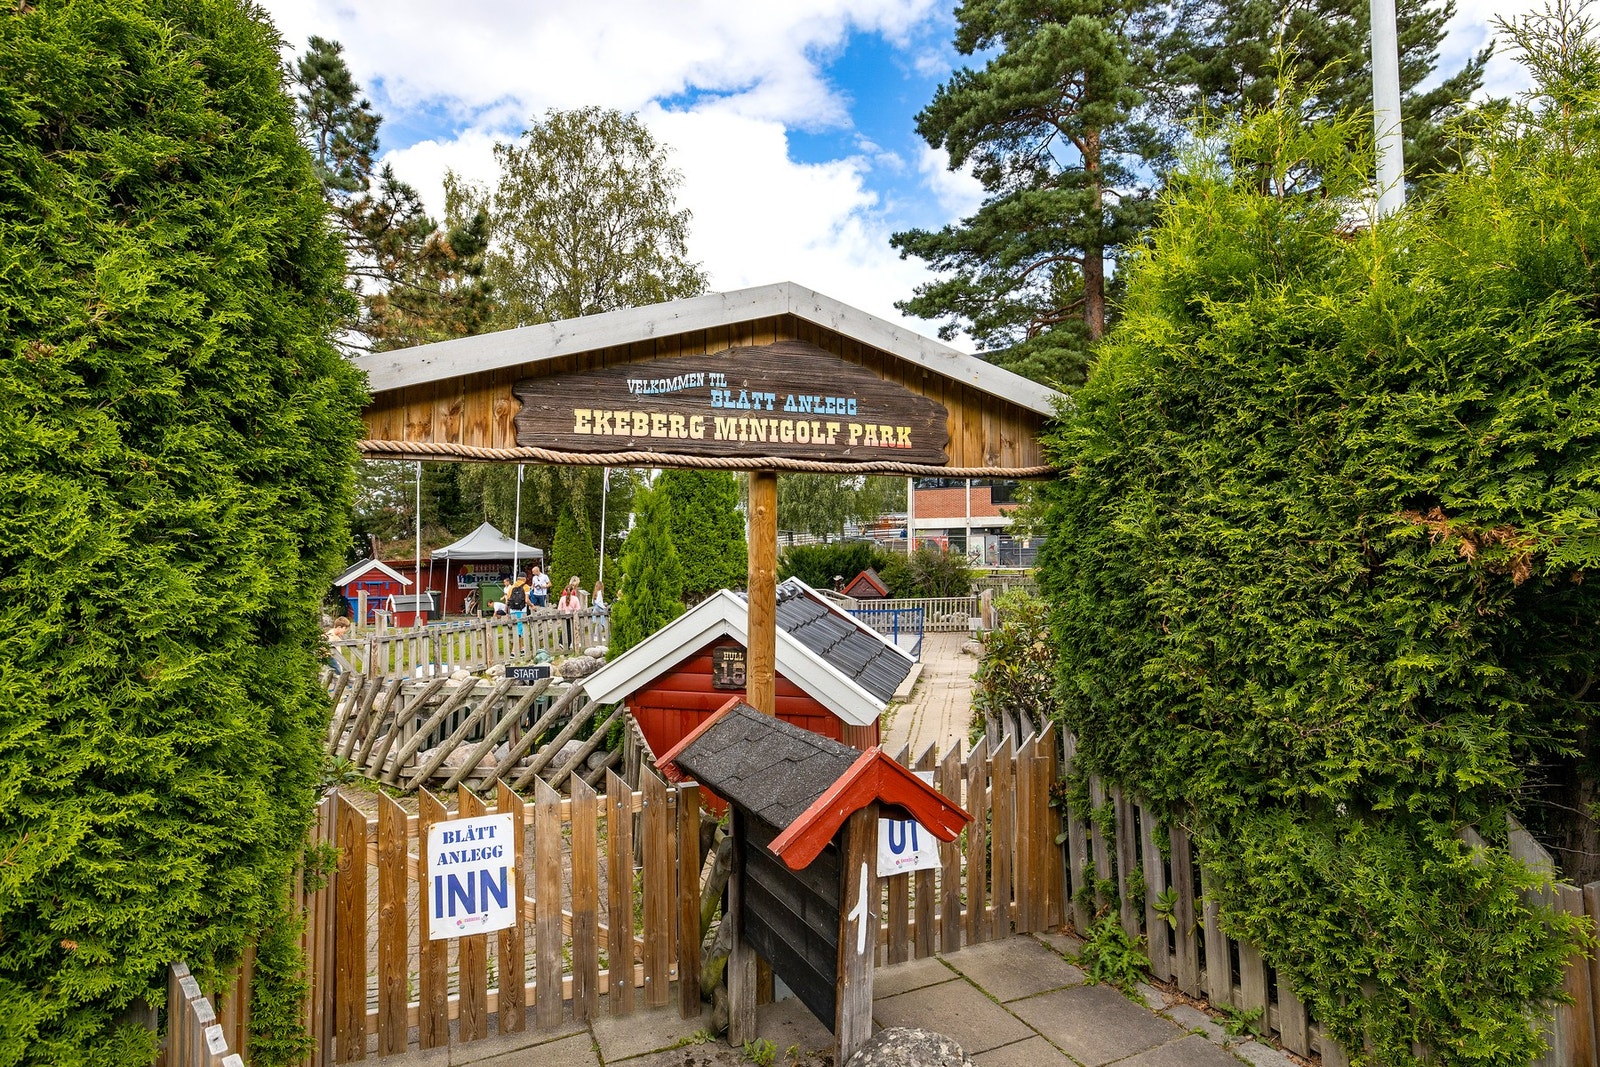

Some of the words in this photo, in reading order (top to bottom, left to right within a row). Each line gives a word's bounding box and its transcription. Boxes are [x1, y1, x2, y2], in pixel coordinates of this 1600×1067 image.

[627, 373, 705, 395] VELKOMMEN
[709, 372, 728, 388] TIL
[710, 388, 776, 411] BLÅTT
[783, 394, 858, 415] ANLEGG
[573, 408, 706, 440] EKEBERG
[714, 416, 841, 445] MINIGOLF
[849, 423, 912, 449] PARK
[723, 651, 744, 661] HULL
[513, 668, 540, 679] START
[442, 824, 498, 845] BLÅTT
[436, 844, 504, 866] ANLEGG
[434, 865, 509, 919] INN
